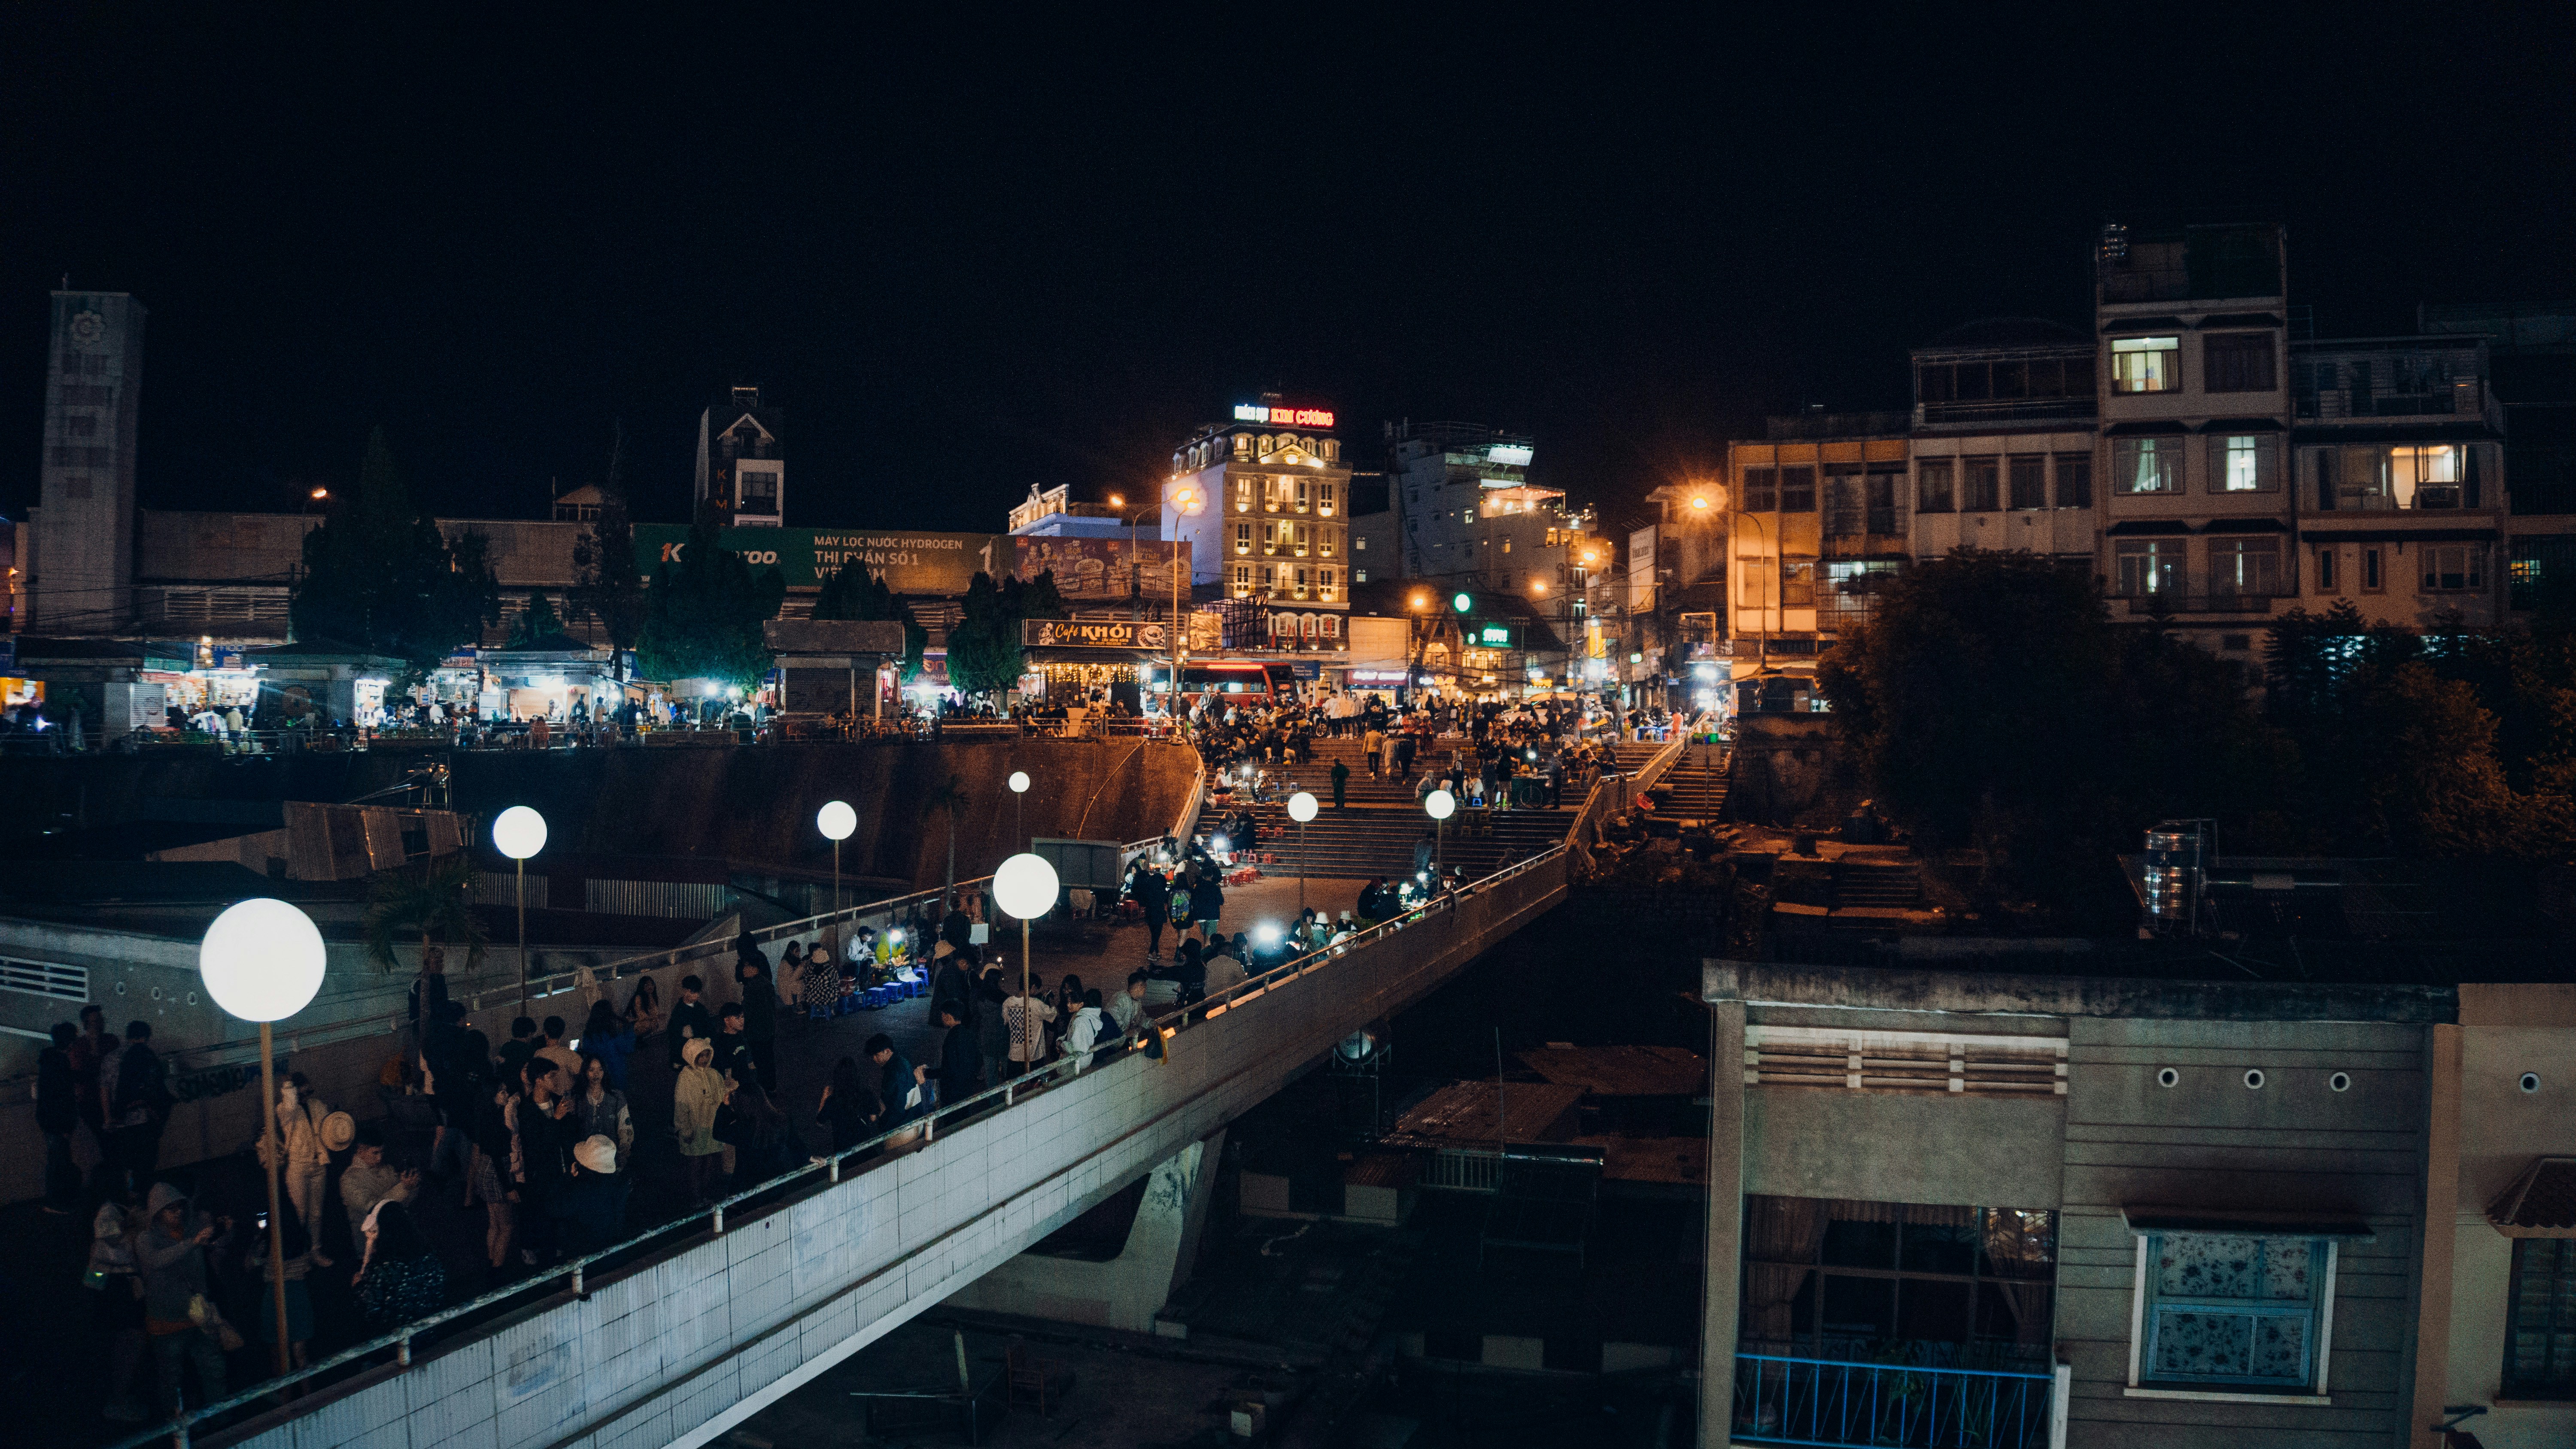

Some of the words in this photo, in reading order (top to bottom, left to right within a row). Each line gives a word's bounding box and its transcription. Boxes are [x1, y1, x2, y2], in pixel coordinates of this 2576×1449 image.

[1271, 408, 1294, 423] KIM
[1296, 409, 1334, 425] CƯƠNG
[843, 537, 864, 549] LỌC
[867, 536, 898, 548] NƯỚC
[901, 538, 963, 550] HYDROGEN
[814, 551, 838, 565] THỊ
[889, 550, 908, 565] SỐ
[912, 554, 919, 566] 1
[1081, 623, 1132, 640] KHÓI
